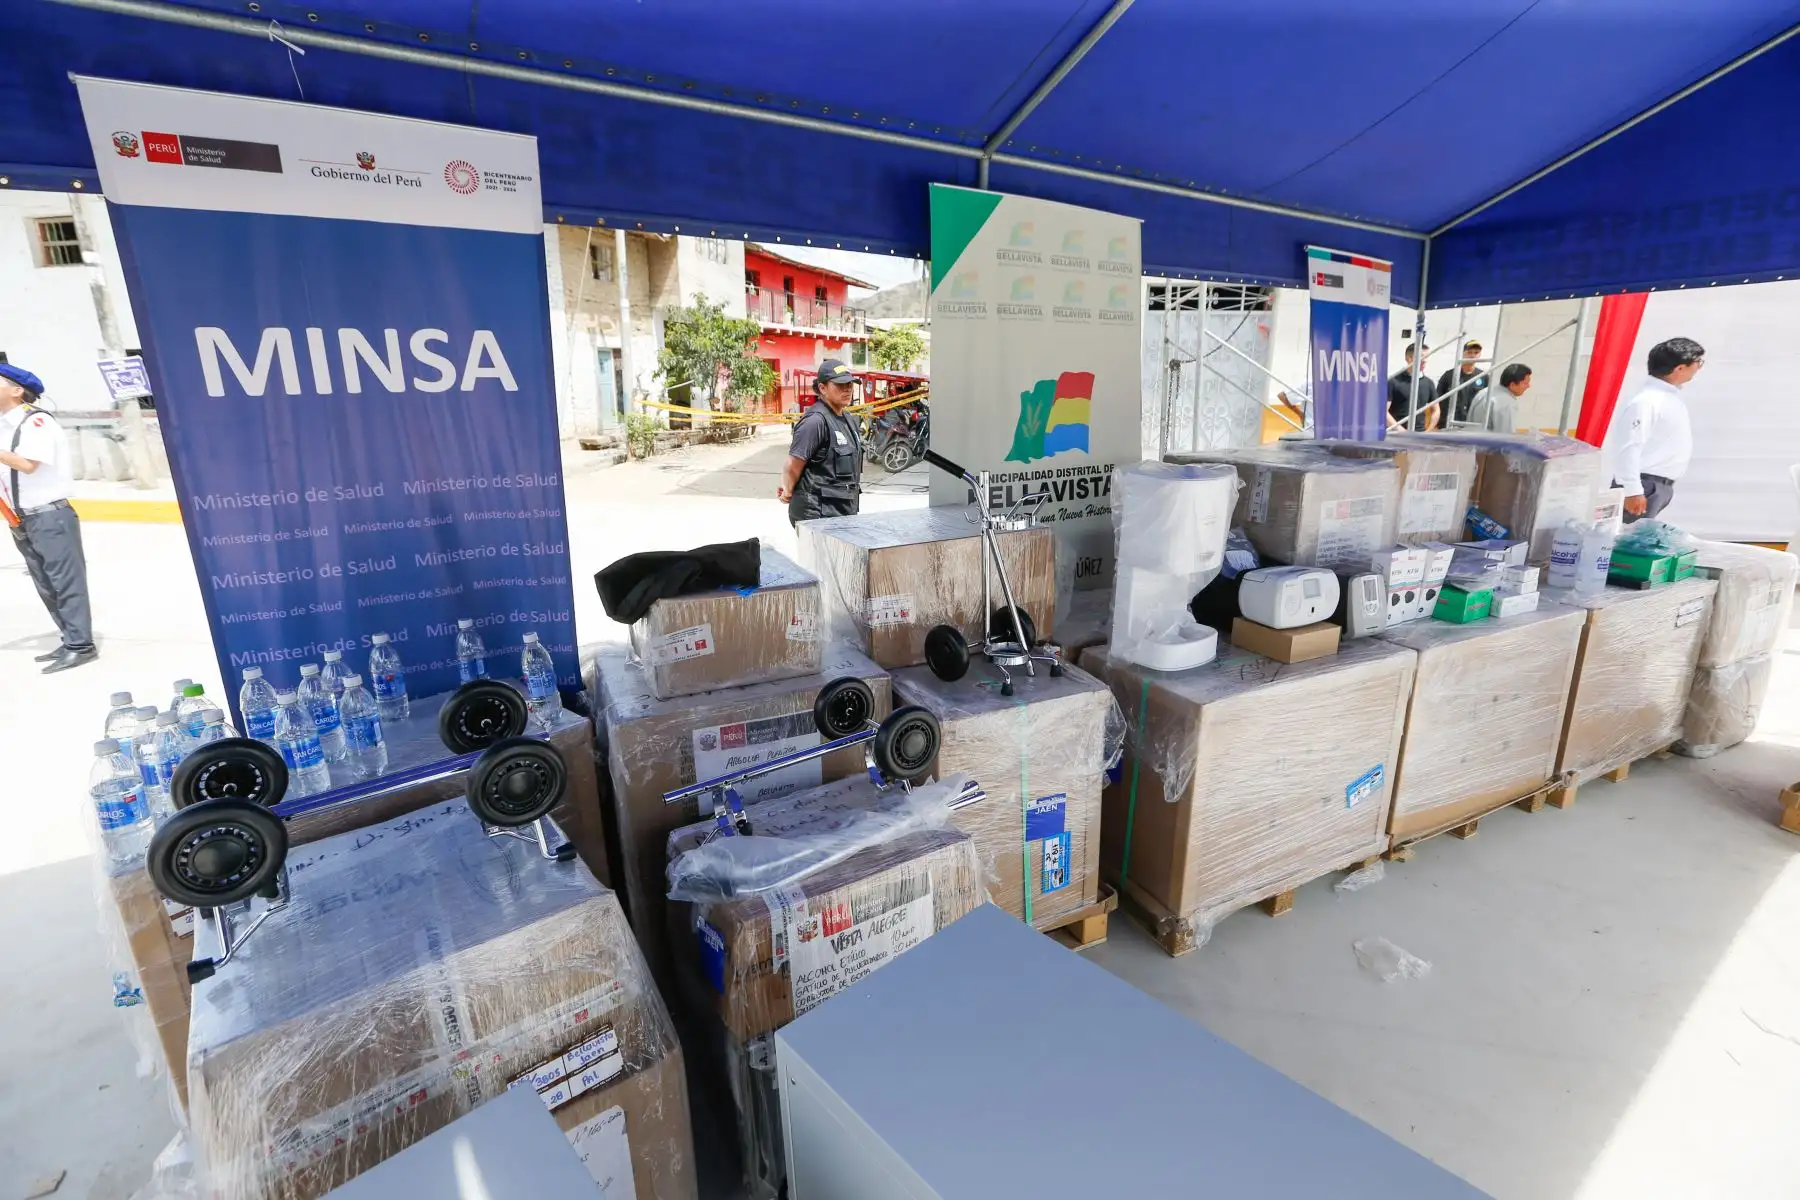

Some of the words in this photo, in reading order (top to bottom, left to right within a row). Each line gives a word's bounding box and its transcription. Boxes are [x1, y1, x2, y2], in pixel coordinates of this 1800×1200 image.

[148, 143, 177, 154] PERÚ
[186, 146, 226, 157] Ministerio
[200, 155, 222, 164] Salud
[311, 166, 370, 182] Gobierno
[373, 173, 392, 185] del
[395, 175, 423, 188] Perú
[484, 171, 533, 182] BICENTENARIO
[996, 251, 1042, 264] BELLAVISTA
[1050, 257, 1091, 270] BELLAVISTA
[937, 304, 988, 314] BELLAVISTA
[996, 305, 1043, 317] BELLAVISTA
[1052, 309, 1092, 319] BELLAVISTA
[194, 326, 519, 397] MINSA
[1319, 350, 1378, 383] MINSA
[1056, 465, 1101, 478] DISTRITAL
[403, 475, 488, 496] Ministerio
[492, 474, 511, 488] de
[515, 472, 558, 488] Salud
[192, 489, 299, 512] Ministerio
[304, 487, 329, 502] de
[333, 482, 385, 501] Salud
[464, 510, 516, 521] Ministerio
[518, 509, 531, 519] de
[533, 507, 561, 518] Salud
[1057, 507, 1083, 522] Nueva
[344, 521, 404, 534] Ministerio
[406, 518, 422, 528] de
[424, 514, 453, 527] Salud
[202, 532, 271, 547] Ministerio
[274, 530, 291, 541] de
[294, 526, 329, 539] Salud
[415, 545, 497, 568] Ministerio
[500, 543, 519, 556] de
[523, 541, 564, 557] Salud
[211, 567, 314, 590] Ministerio
[319, 563, 343, 578] de
[347, 555, 396, 576] Salud
[473, 578, 523, 590] Ministerio
[526, 577, 538, 586] de
[540, 575, 567, 585] Salud
[358, 590, 416, 608] Ministerio
[418, 589, 433, 599] de
[435, 585, 464, 598] Salud
[220, 609, 287, 625] Ministerio
[290, 605, 306, 616] de
[309, 600, 343, 613] Salud
[509, 611, 528, 623] de
[530, 610, 570, 623] Salud
[229, 641, 329, 667] Ministerio
[333, 638, 357, 651] de
[430, 661, 443, 669] de
[867, 908, 907, 939] ALEGRE
[795, 963, 838, 986] ALCOHOL
[831, 973, 841, 983] DE
[838, 979, 848, 989] DE
